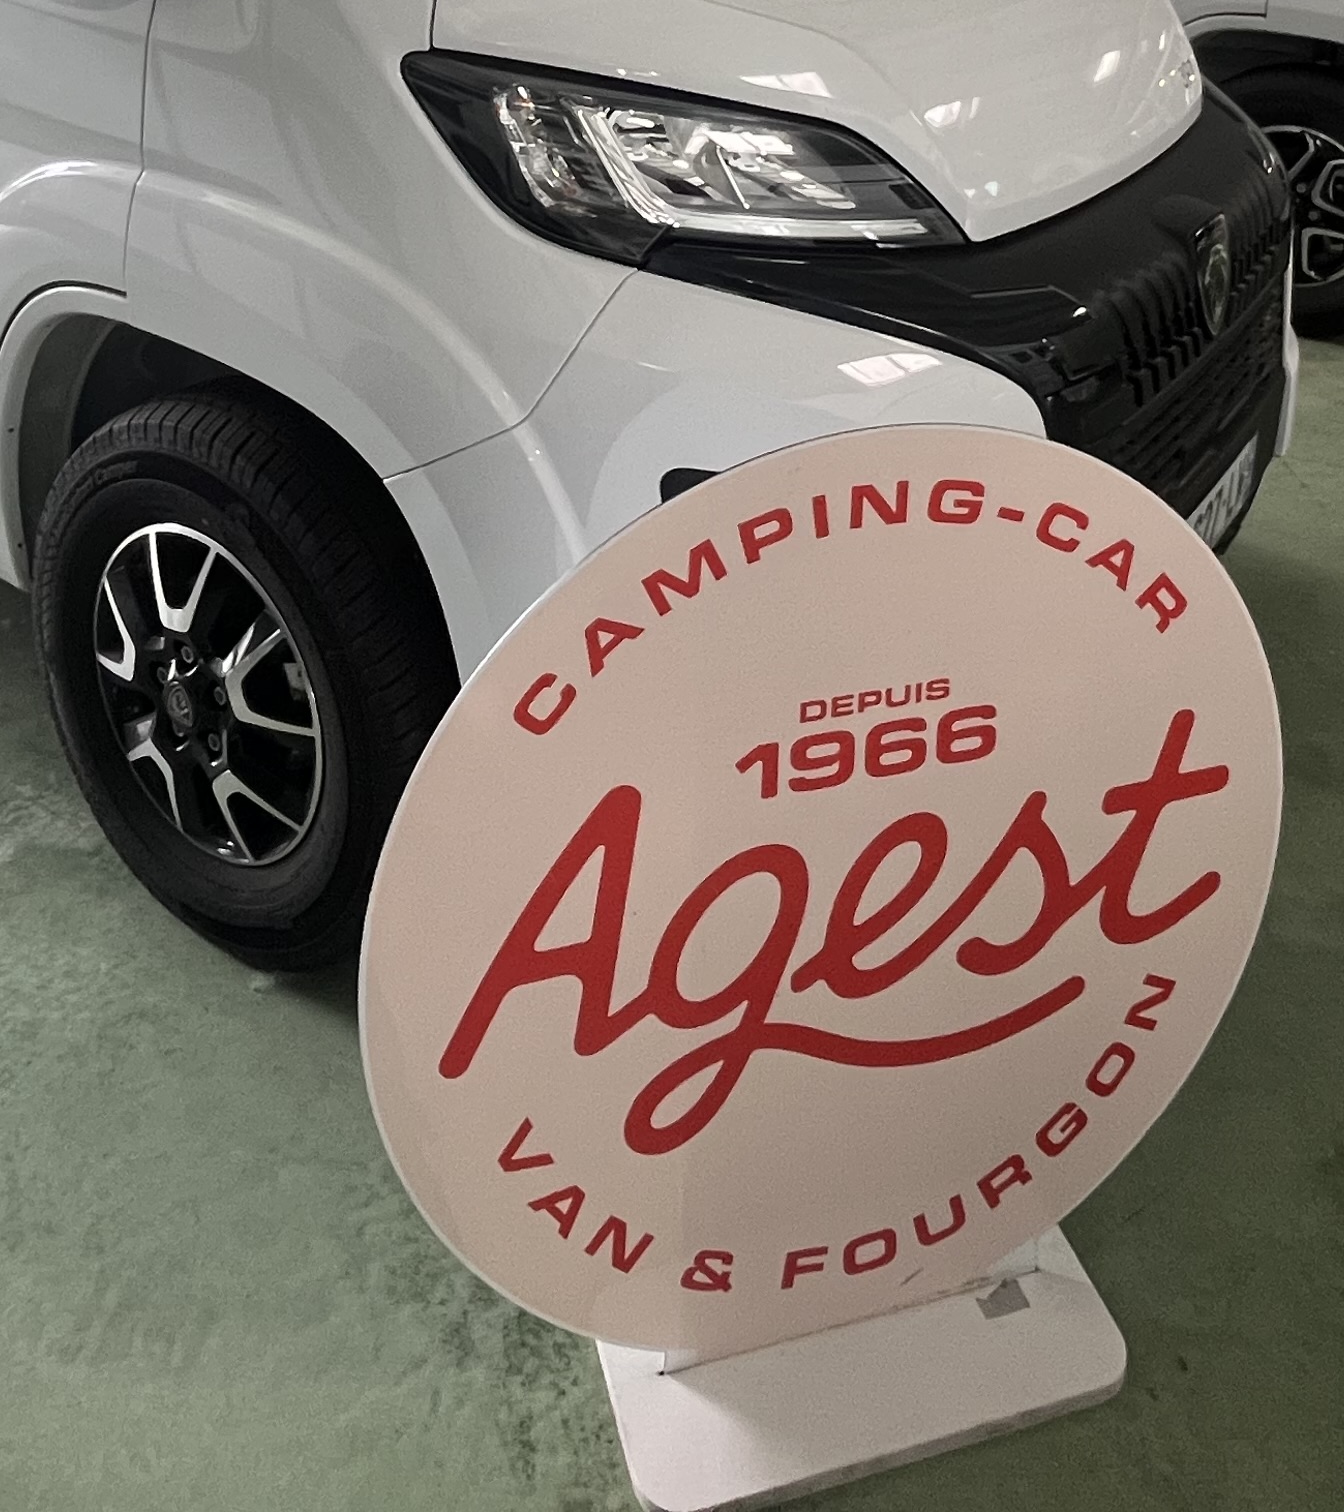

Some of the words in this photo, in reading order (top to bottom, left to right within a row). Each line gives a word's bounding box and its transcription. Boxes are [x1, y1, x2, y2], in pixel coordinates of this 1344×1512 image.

[512, 478, 1188, 736] CAMPING-CAR
[798, 678, 951, 724] DEPUIS
[735, 704, 998, 800] 1966
[438, 709, 1231, 1156] Agest
[498, 1119, 653, 1273] VAN
[681, 1250, 733, 1292] &
[781, 974, 1176, 1288] FOURGON
